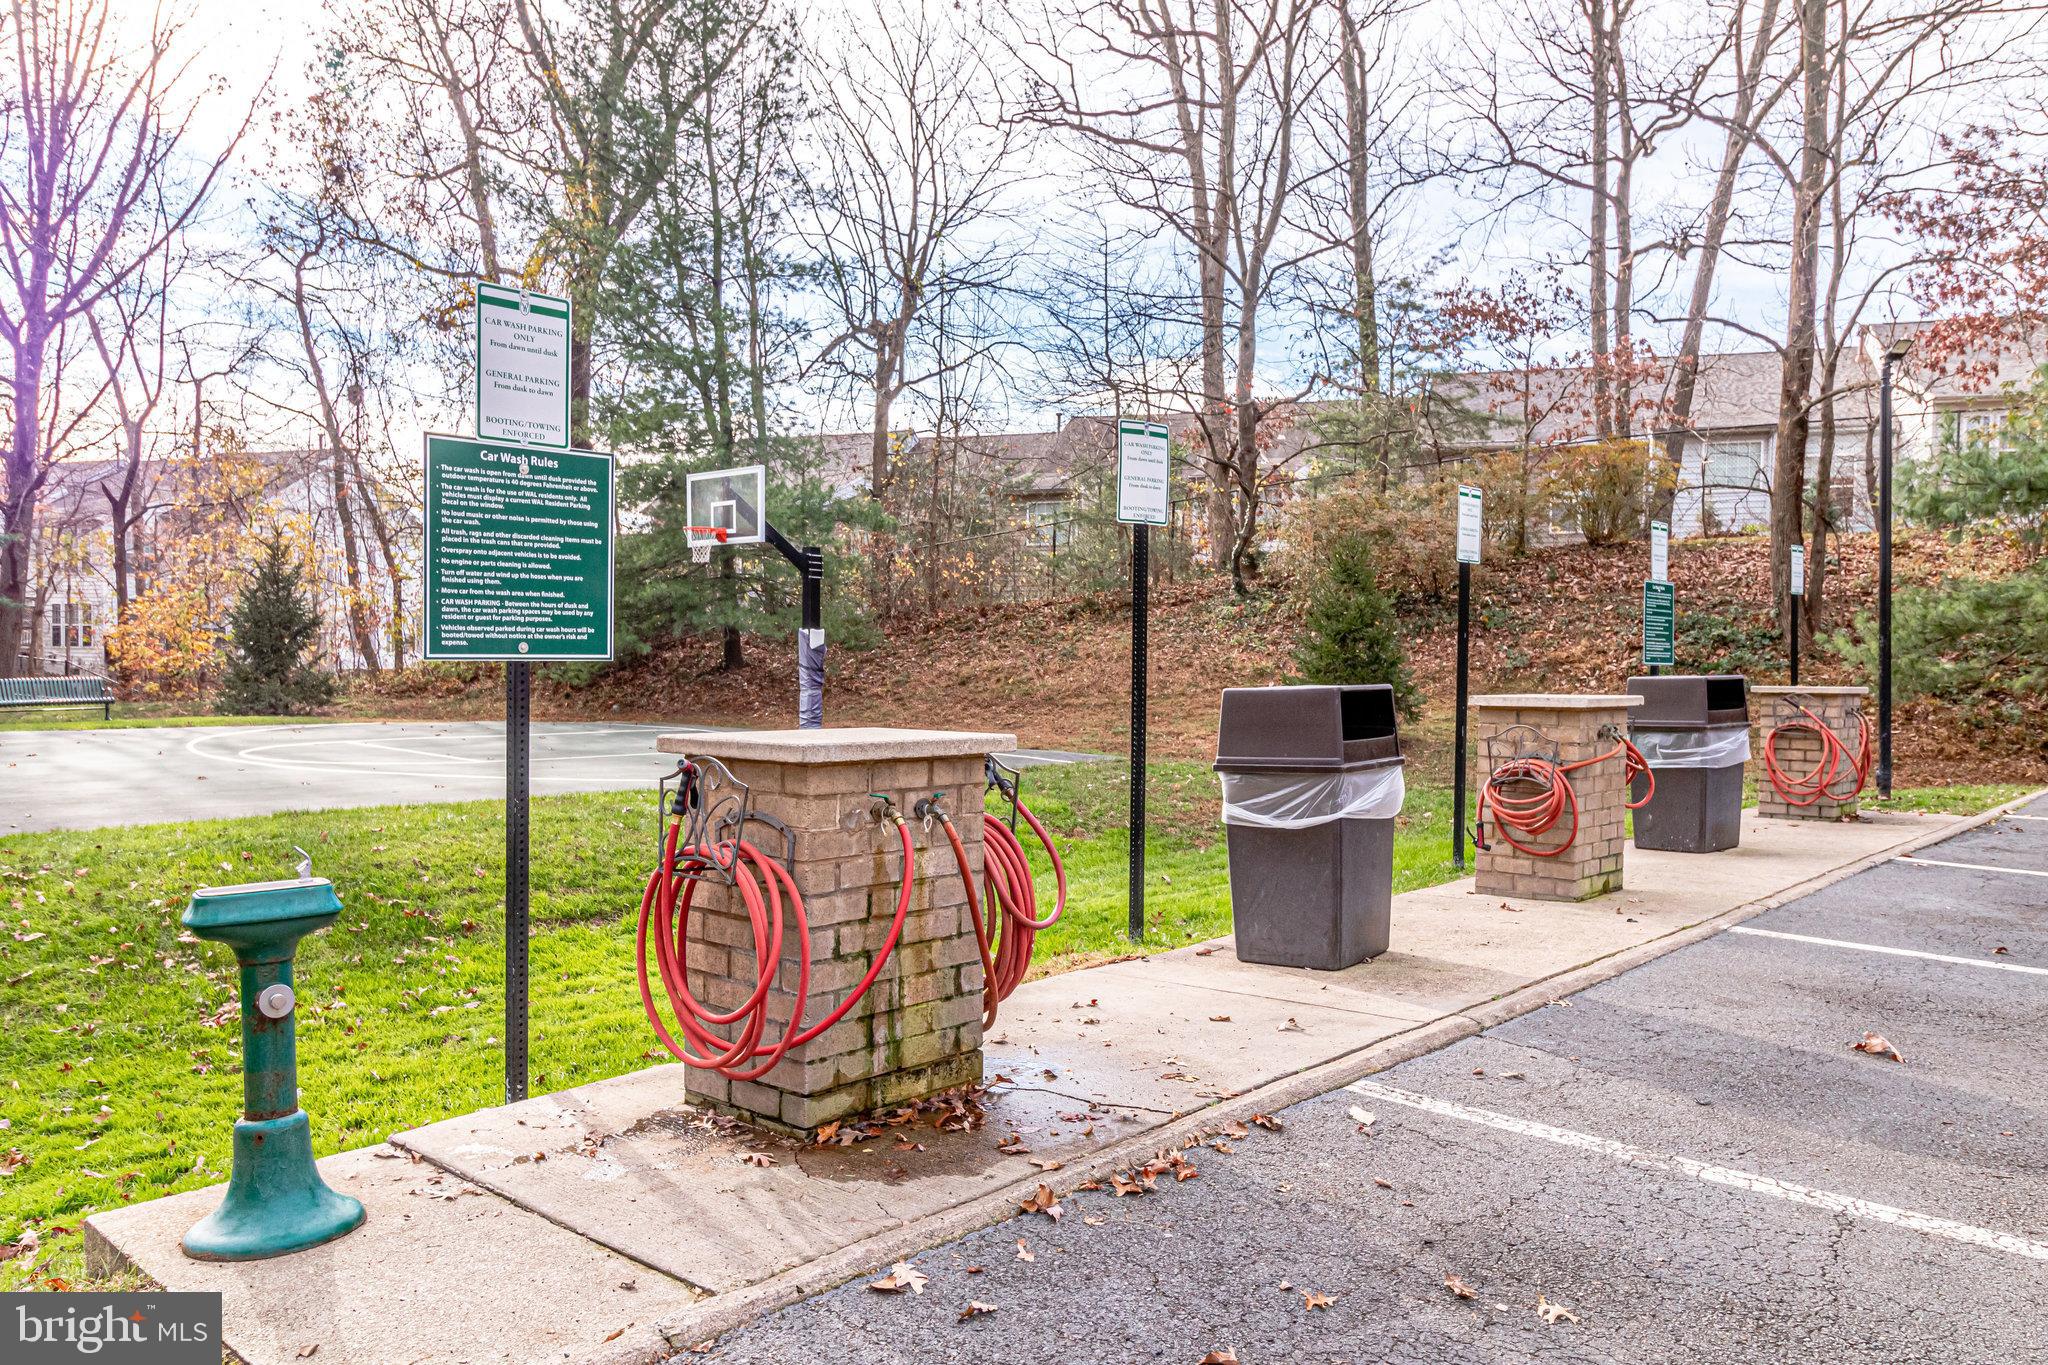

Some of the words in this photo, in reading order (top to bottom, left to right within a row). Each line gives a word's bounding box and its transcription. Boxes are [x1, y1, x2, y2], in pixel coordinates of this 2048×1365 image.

[485, 317, 501, 326] CAR
[504, 320, 526, 331] WASH
[528, 325, 562, 338] PARKING
[514, 333, 535, 343] ONLY
[490, 339, 507, 348] From
[509, 342, 525, 352] dawn
[527, 346, 542, 354] until
[543, 348, 557, 357] dusk
[486, 369, 523, 382] GENERAL
[525, 376, 559, 387] PARKING
[494, 381, 511, 390] From
[513, 384, 527, 392] dusk
[537, 388, 553, 396] dawn
[486, 416, 560, 432] BOOTING/TOWING
[503, 429, 545, 441] ENFORCED
[480, 450, 498, 461] Car
[500, 452, 528, 465] Wash
[531, 456, 558, 468] Rules
[468, 474, 504, 484] temperature
[543, 482, 572, 490] Fahrenheit
[483, 494, 504, 503] display
[570, 502, 590, 510] Parking
[441, 547, 472, 555] Overspray
